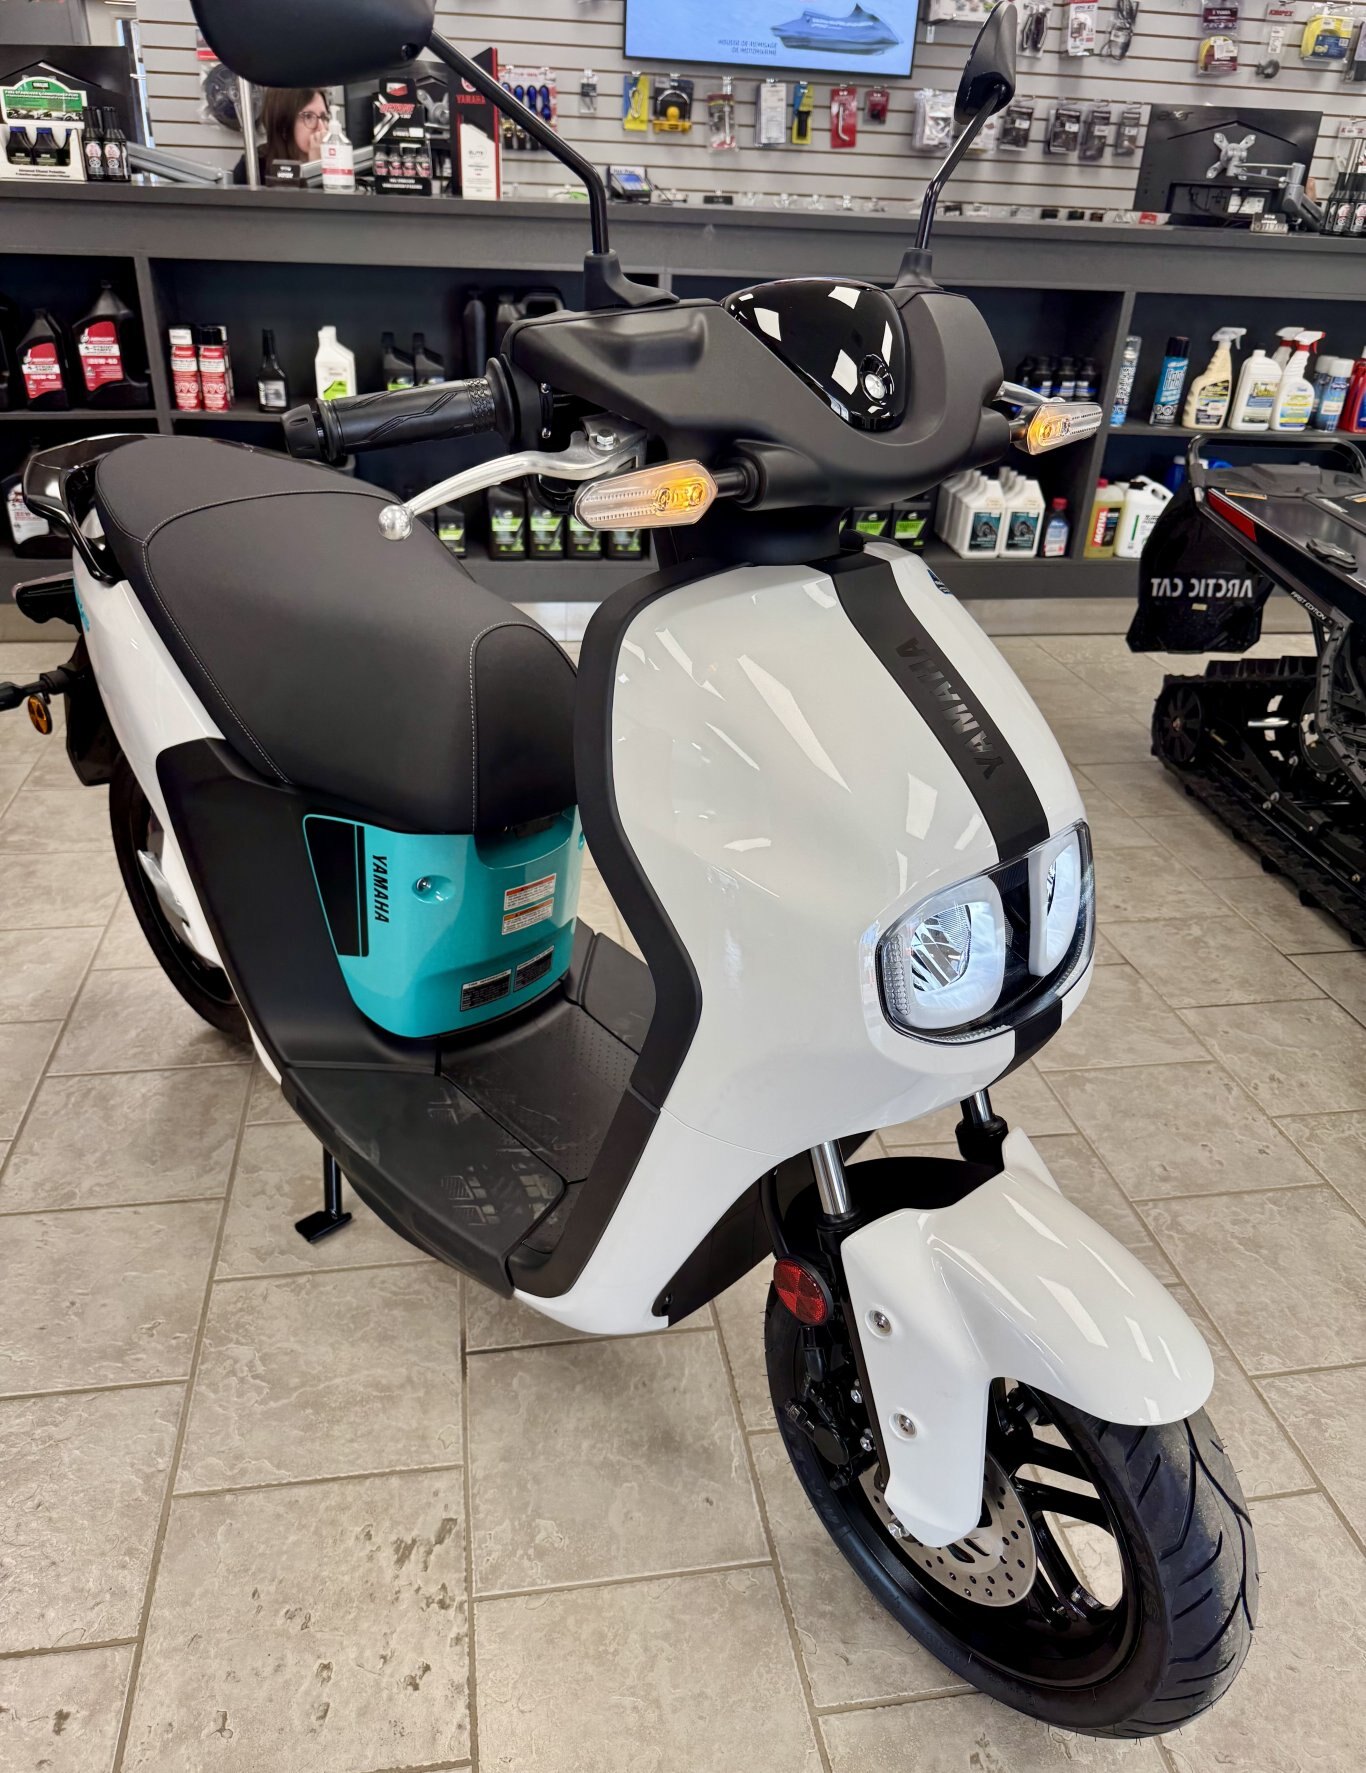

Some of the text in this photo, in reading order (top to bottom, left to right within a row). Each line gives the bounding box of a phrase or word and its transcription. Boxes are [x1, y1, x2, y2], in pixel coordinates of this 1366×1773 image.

[456, 94, 486, 104] YAMAHA
[1157, 110, 1194, 121] acer
[1093, 511, 1108, 544] MOTUL
[1290, 590, 1326, 621] FIRST EDITION
[896, 636, 1006, 780] YAMAHA
[371, 854, 390, 923] YAMAHA
